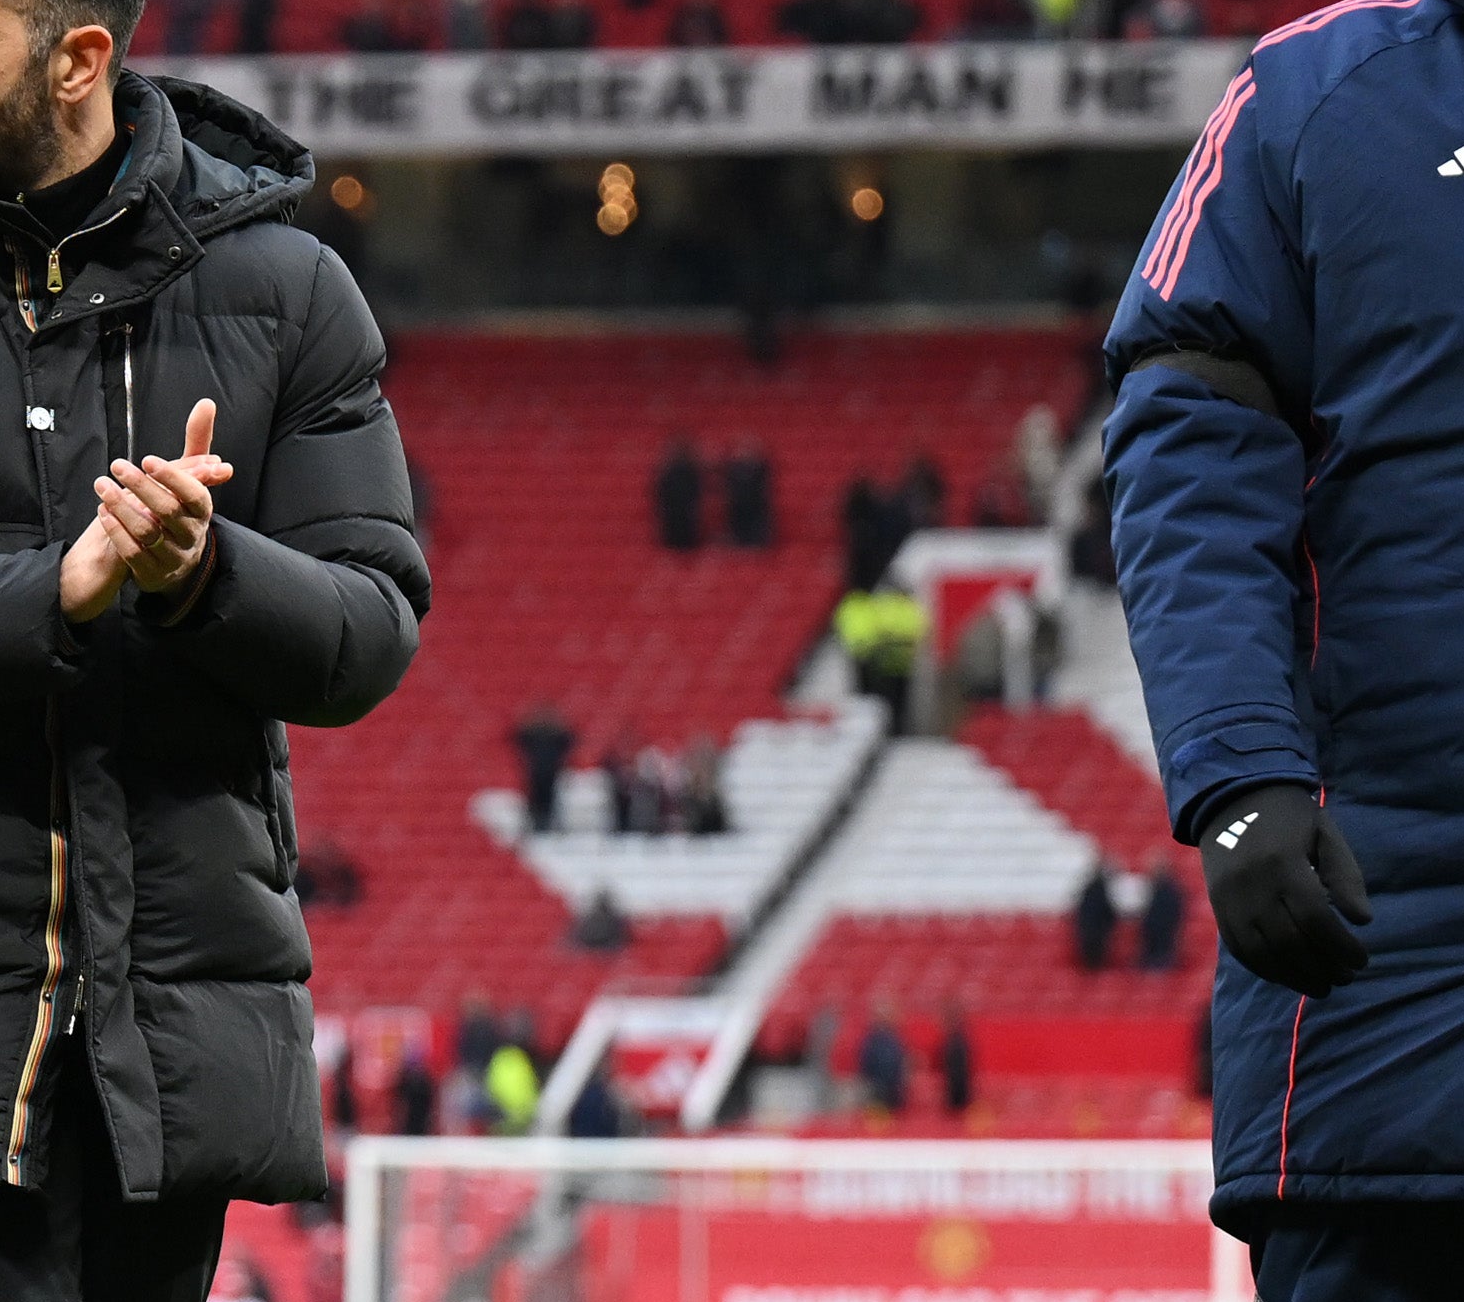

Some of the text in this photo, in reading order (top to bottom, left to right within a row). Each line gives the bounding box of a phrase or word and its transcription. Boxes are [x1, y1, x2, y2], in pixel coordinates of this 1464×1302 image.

[265, 72, 421, 128] THE
[468, 68, 758, 126] GREAT
[809, 65, 1015, 122] MAN
